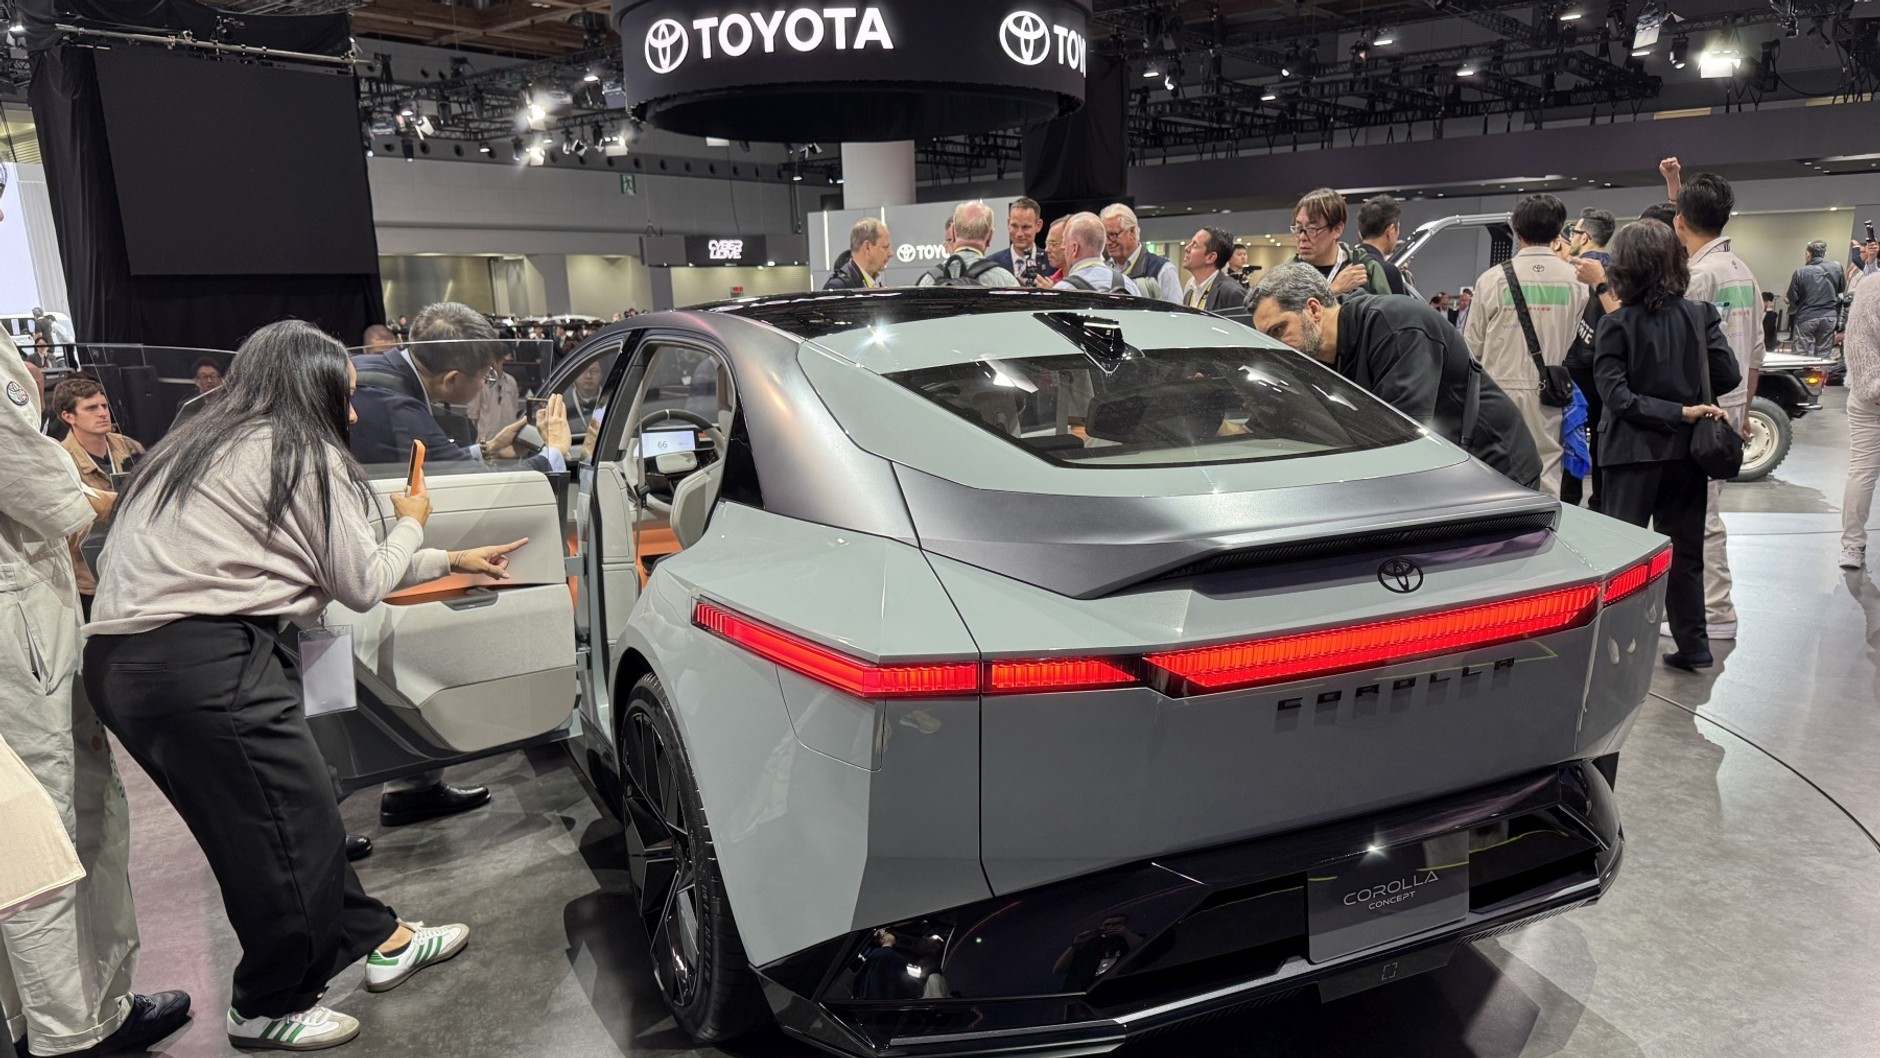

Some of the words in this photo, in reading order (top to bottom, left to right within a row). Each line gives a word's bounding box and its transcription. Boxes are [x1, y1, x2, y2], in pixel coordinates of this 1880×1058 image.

[693, 8, 893, 59] TOYOTA
[1053, 24, 1086, 78] TOY
[708, 239, 743, 251] CYBER
[709, 249, 742, 260] LOVE
[1277, 657, 1515, 711] COROLLA
[1343, 870, 1439, 906] COROLLA
[1368, 890, 1416, 910] CONCEPT
